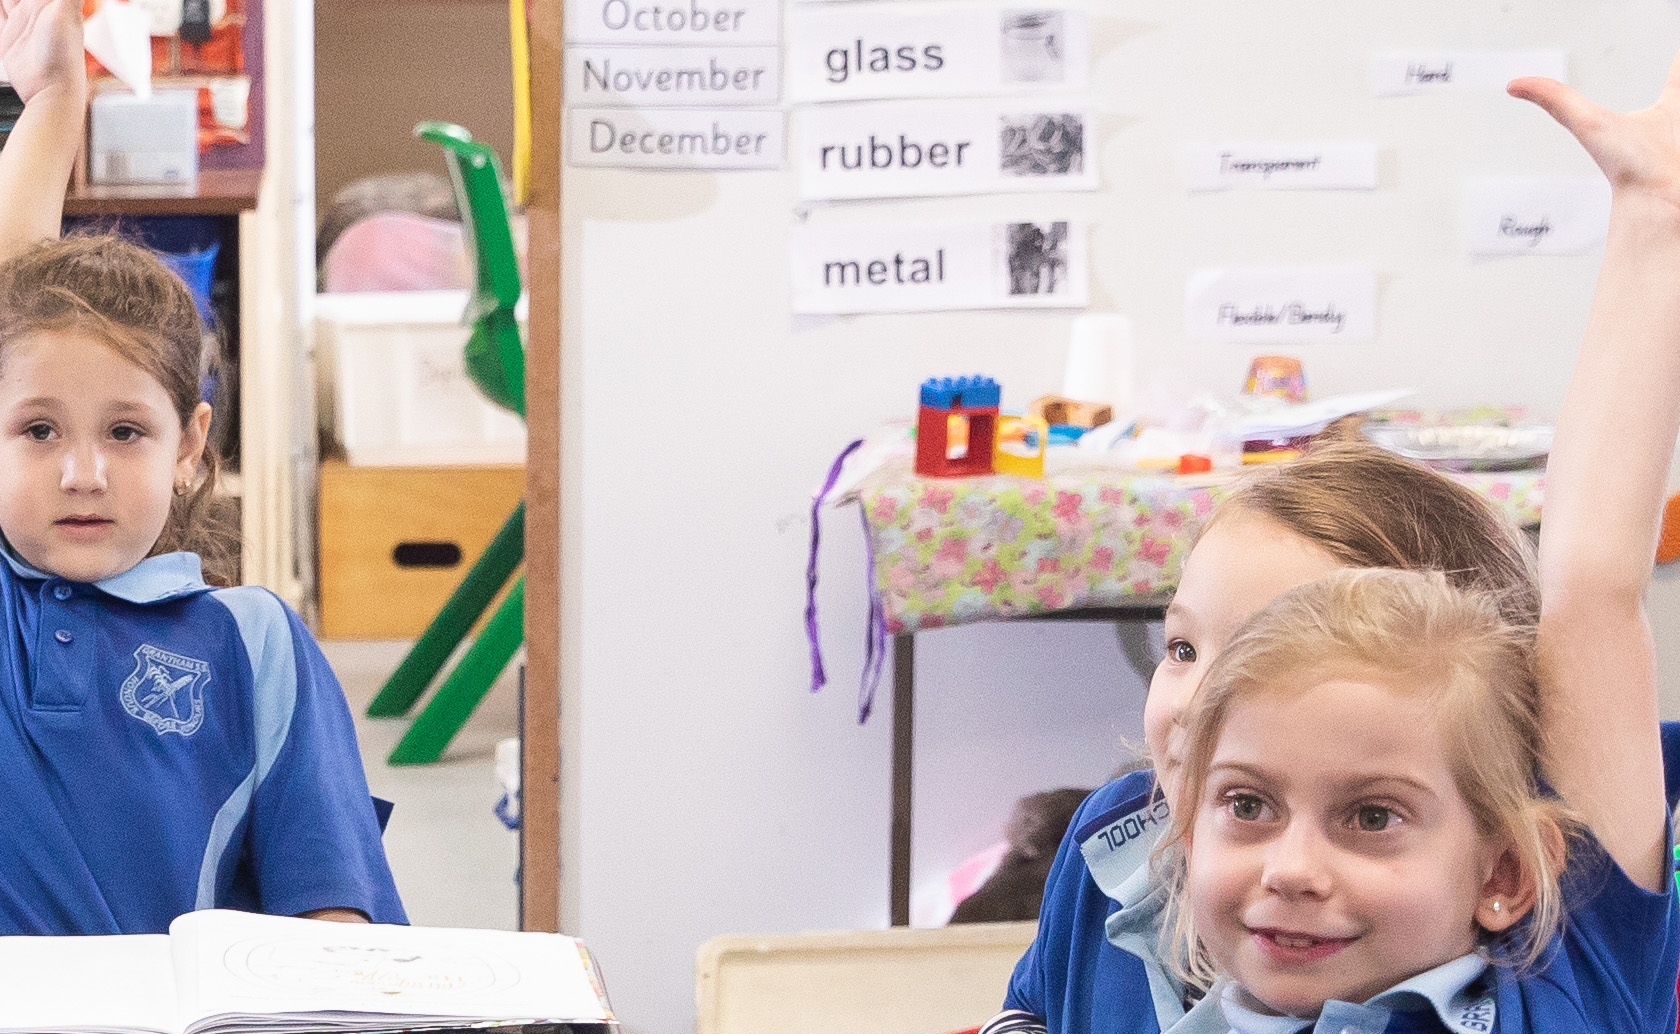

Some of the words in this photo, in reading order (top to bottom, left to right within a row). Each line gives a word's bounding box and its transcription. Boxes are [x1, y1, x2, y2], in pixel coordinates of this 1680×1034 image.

[601, 0, 747, 33] October
[582, 58, 765, 92] November
[825, 39, 946, 83] glass
[589, 119, 768, 156] December
[820, 135, 971, 171] rubber
[824, 248, 946, 287] metal
[1098, 802, 1170, 852] CHOOL
